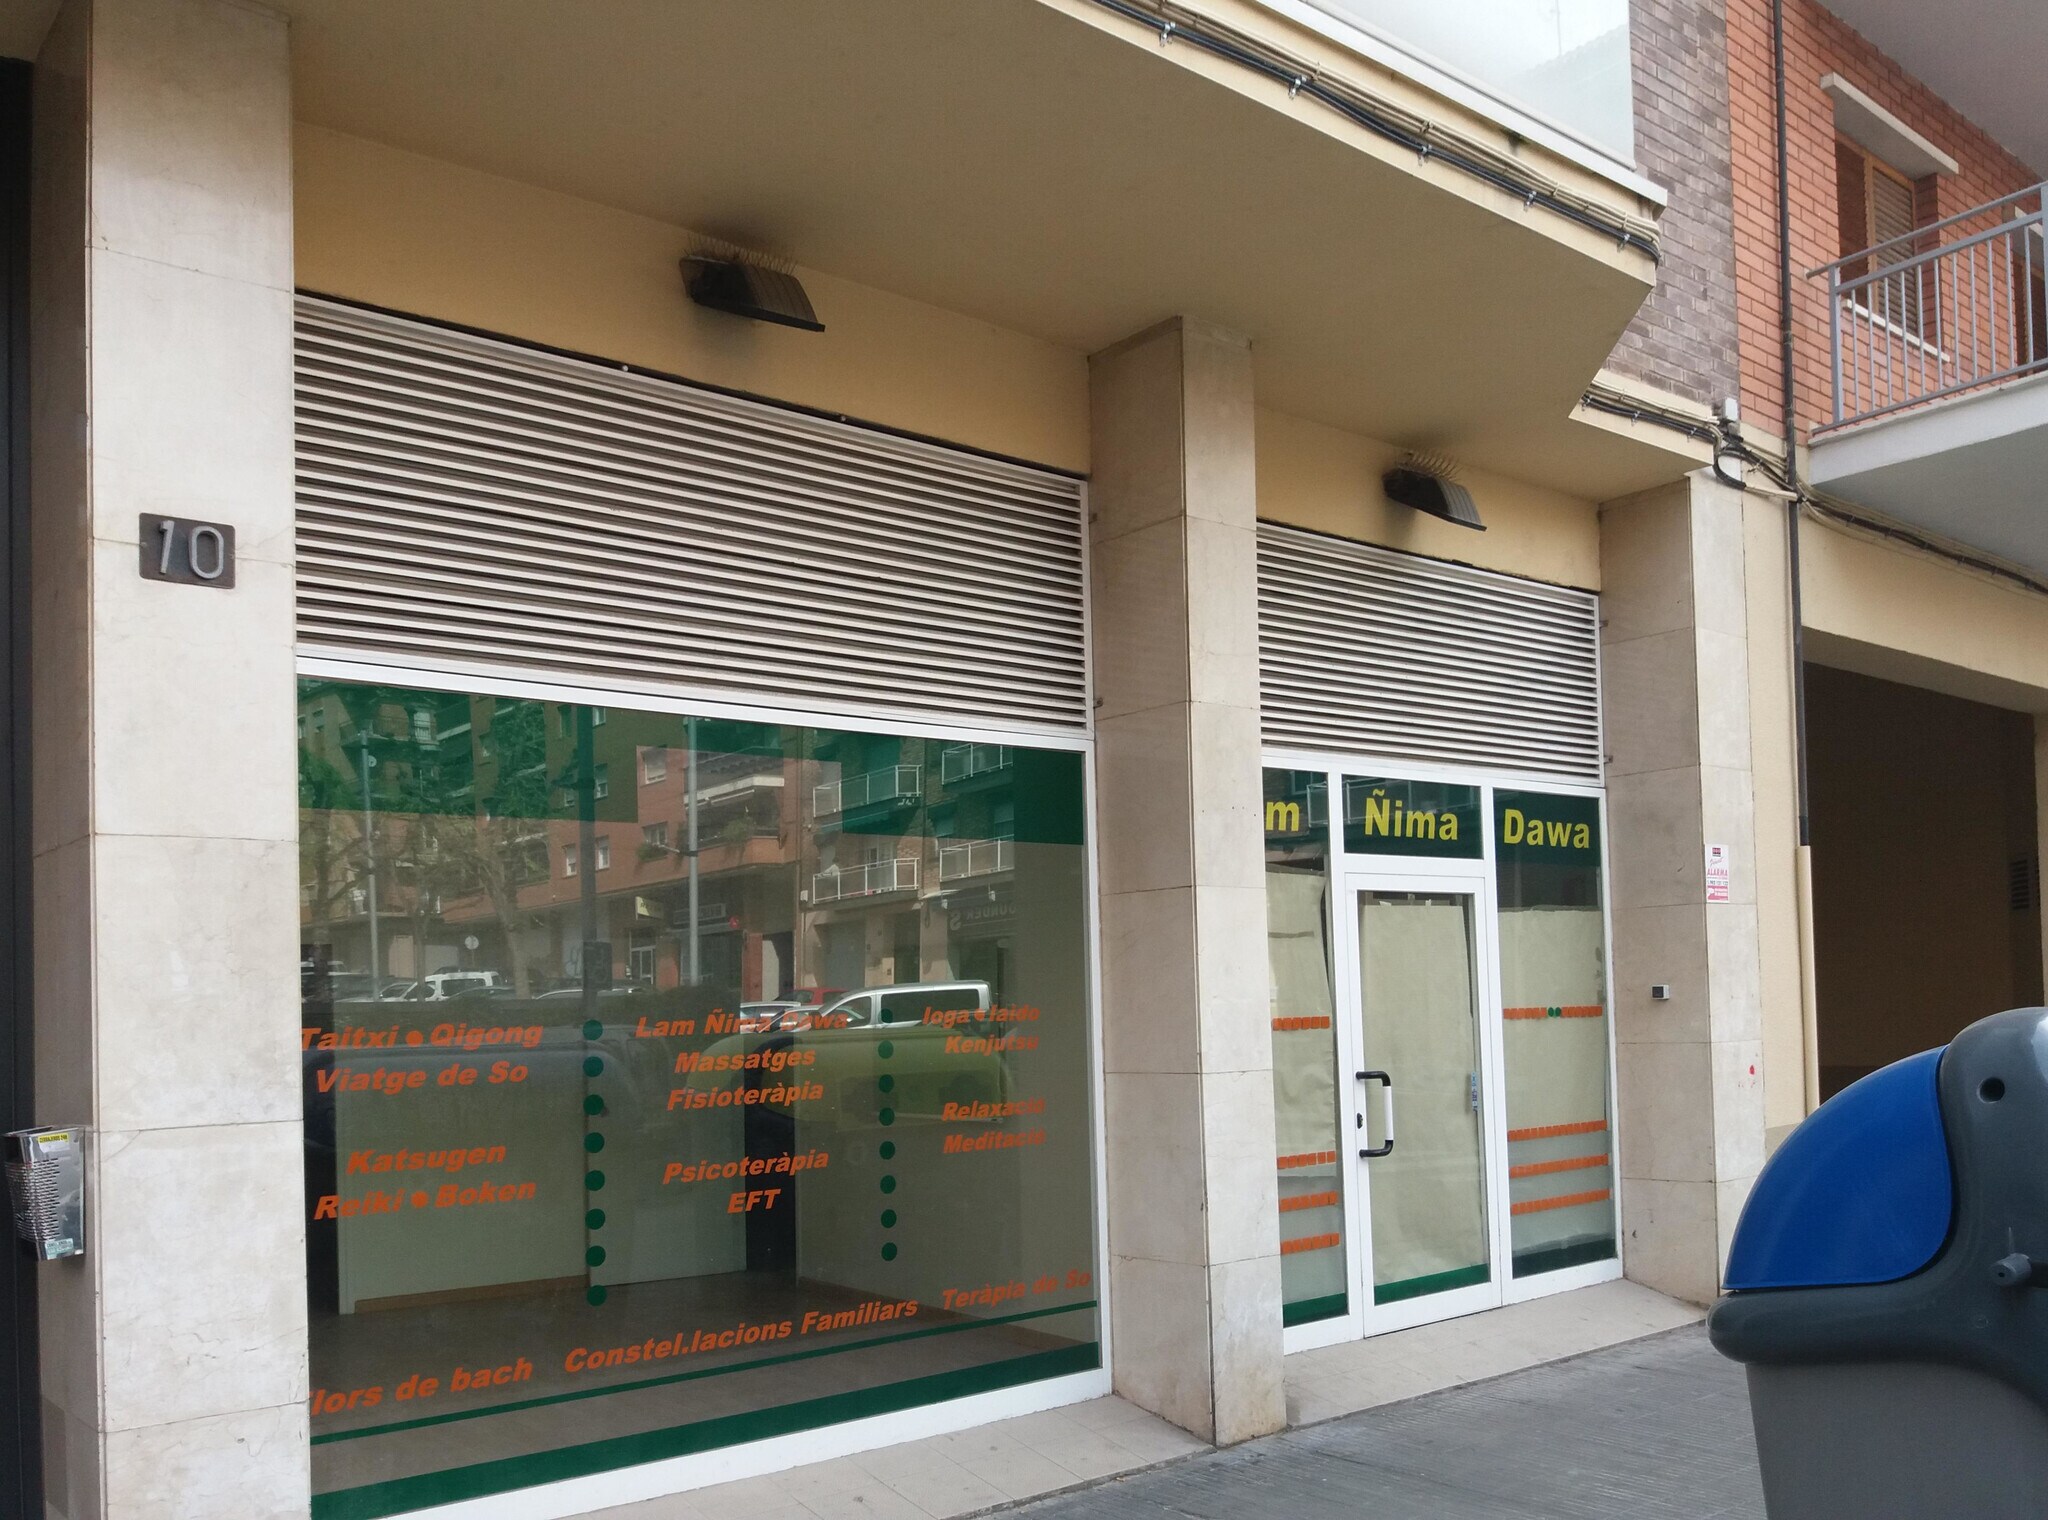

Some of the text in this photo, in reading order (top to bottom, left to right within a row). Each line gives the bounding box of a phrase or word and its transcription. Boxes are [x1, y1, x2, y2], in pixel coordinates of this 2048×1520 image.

[161, 519, 224, 580] 10
[1364, 788, 1459, 841] Ñima
[1503, 808, 1590, 849] Dawa
[301, 1022, 544, 1051] Taitxi Qigong
[634, 1016, 696, 1038] Lam
[704, 1007, 772, 1034] Ñima
[944, 1034, 1040, 1056] Kenjutsu
[674, 1049, 816, 1073] Massatges
[316, 1060, 529, 1095] Viatge de So
[667, 1080, 824, 1111] Fisioteràpia
[346, 1144, 507, 1175] Katsugen
[663, 1149, 829, 1185] Psicoteràpia
[314, 1181, 537, 1220] Reiki Boken
[727, 1189, 781, 1214] EFT
[308, 1269, 1091, 1418] lors de bach Constel.lacions Familiars Teràpia de So
